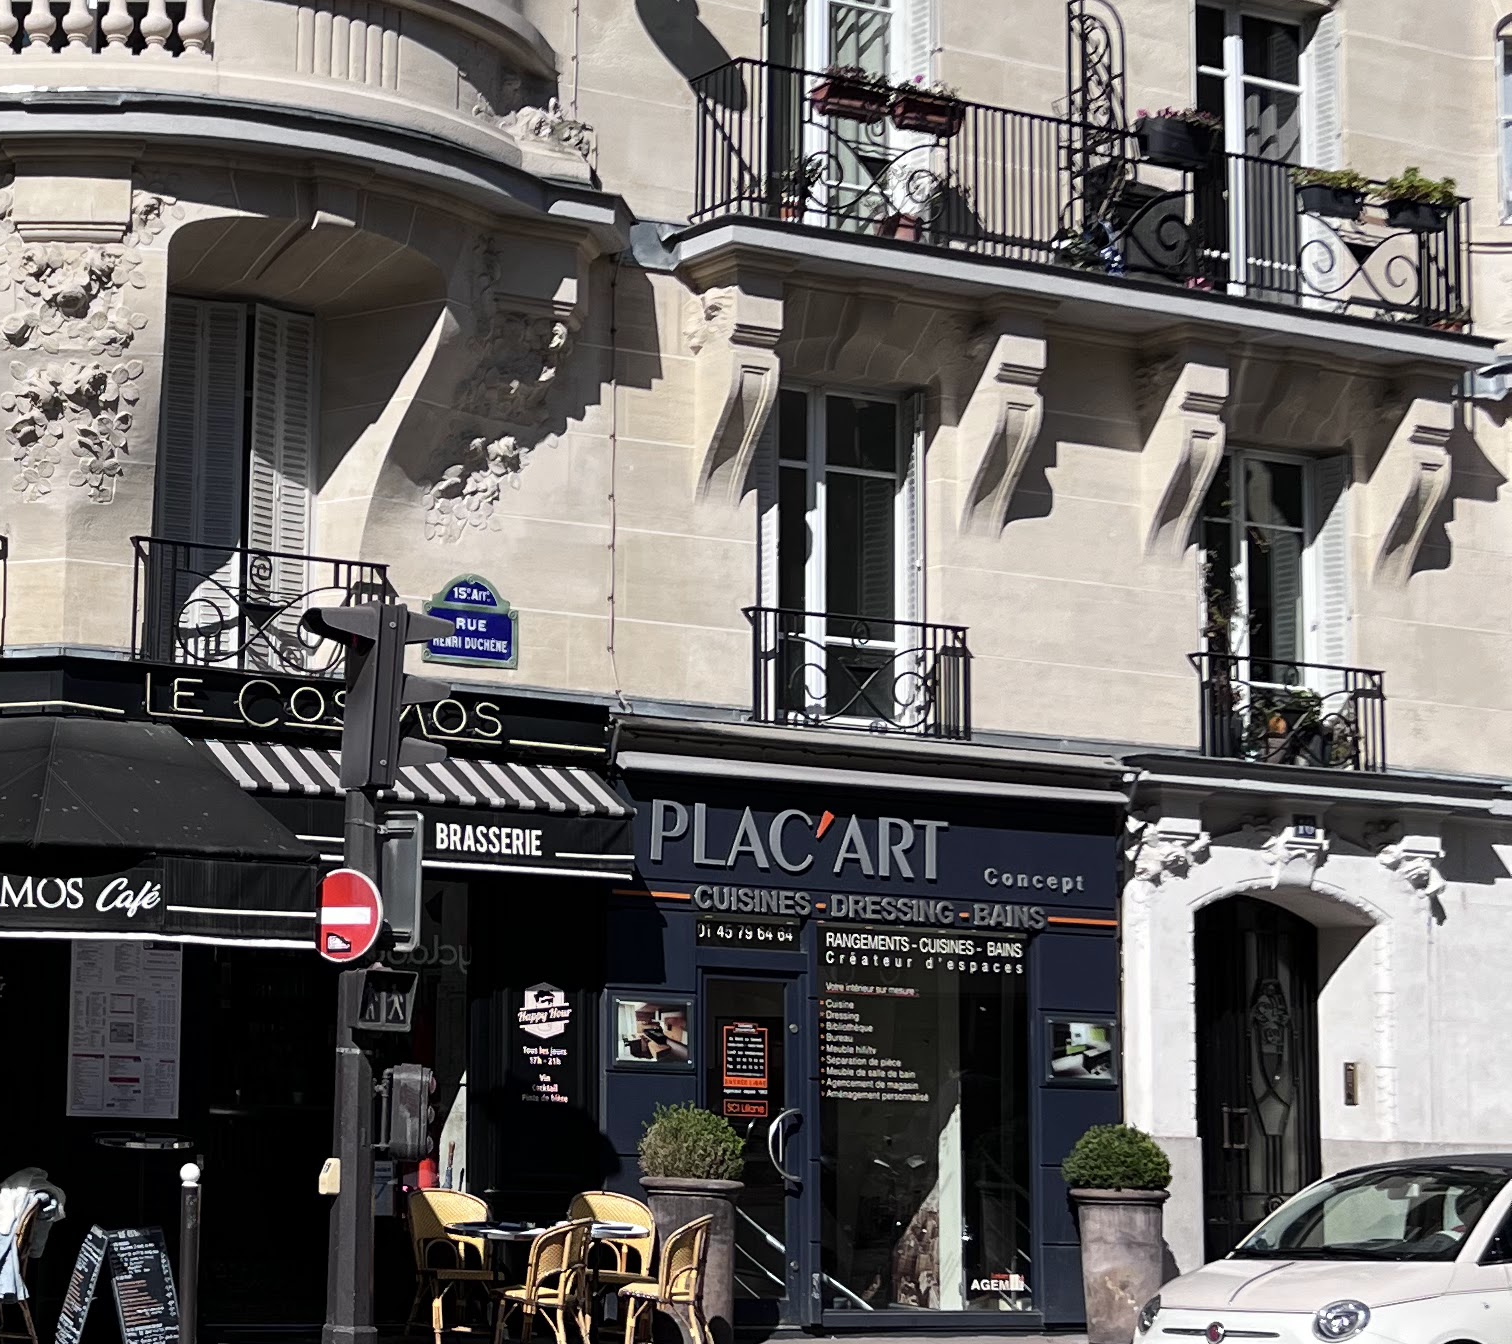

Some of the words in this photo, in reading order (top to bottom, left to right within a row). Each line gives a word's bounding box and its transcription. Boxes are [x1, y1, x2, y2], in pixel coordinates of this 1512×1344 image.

[456, 617, 487, 632] RUE
[144, 672, 205, 718] LE
[435, 822, 544, 857] BRASSERIE
[648, 797, 950, 882] PLAC'ART
[983, 867, 1085, 894] Concept
[95, 877, 161, 918] Café
[693, 885, 810, 918] CUISINES
[830, 894, 954, 927] DRESSING
[972, 903, 1047, 933] BAINS
[716, 924, 734, 940] 45
[825, 931, 910, 953] RANGEMENTS
[919, 937, 976, 956] CUISINES
[986, 941, 1024, 959] BAINS
[825, 950, 913, 968] Créateur
[825, 999, 855, 1010] Cuisine
[825, 1010, 860, 1023] Dressing
[825, 1032, 854, 1043] Bureau
